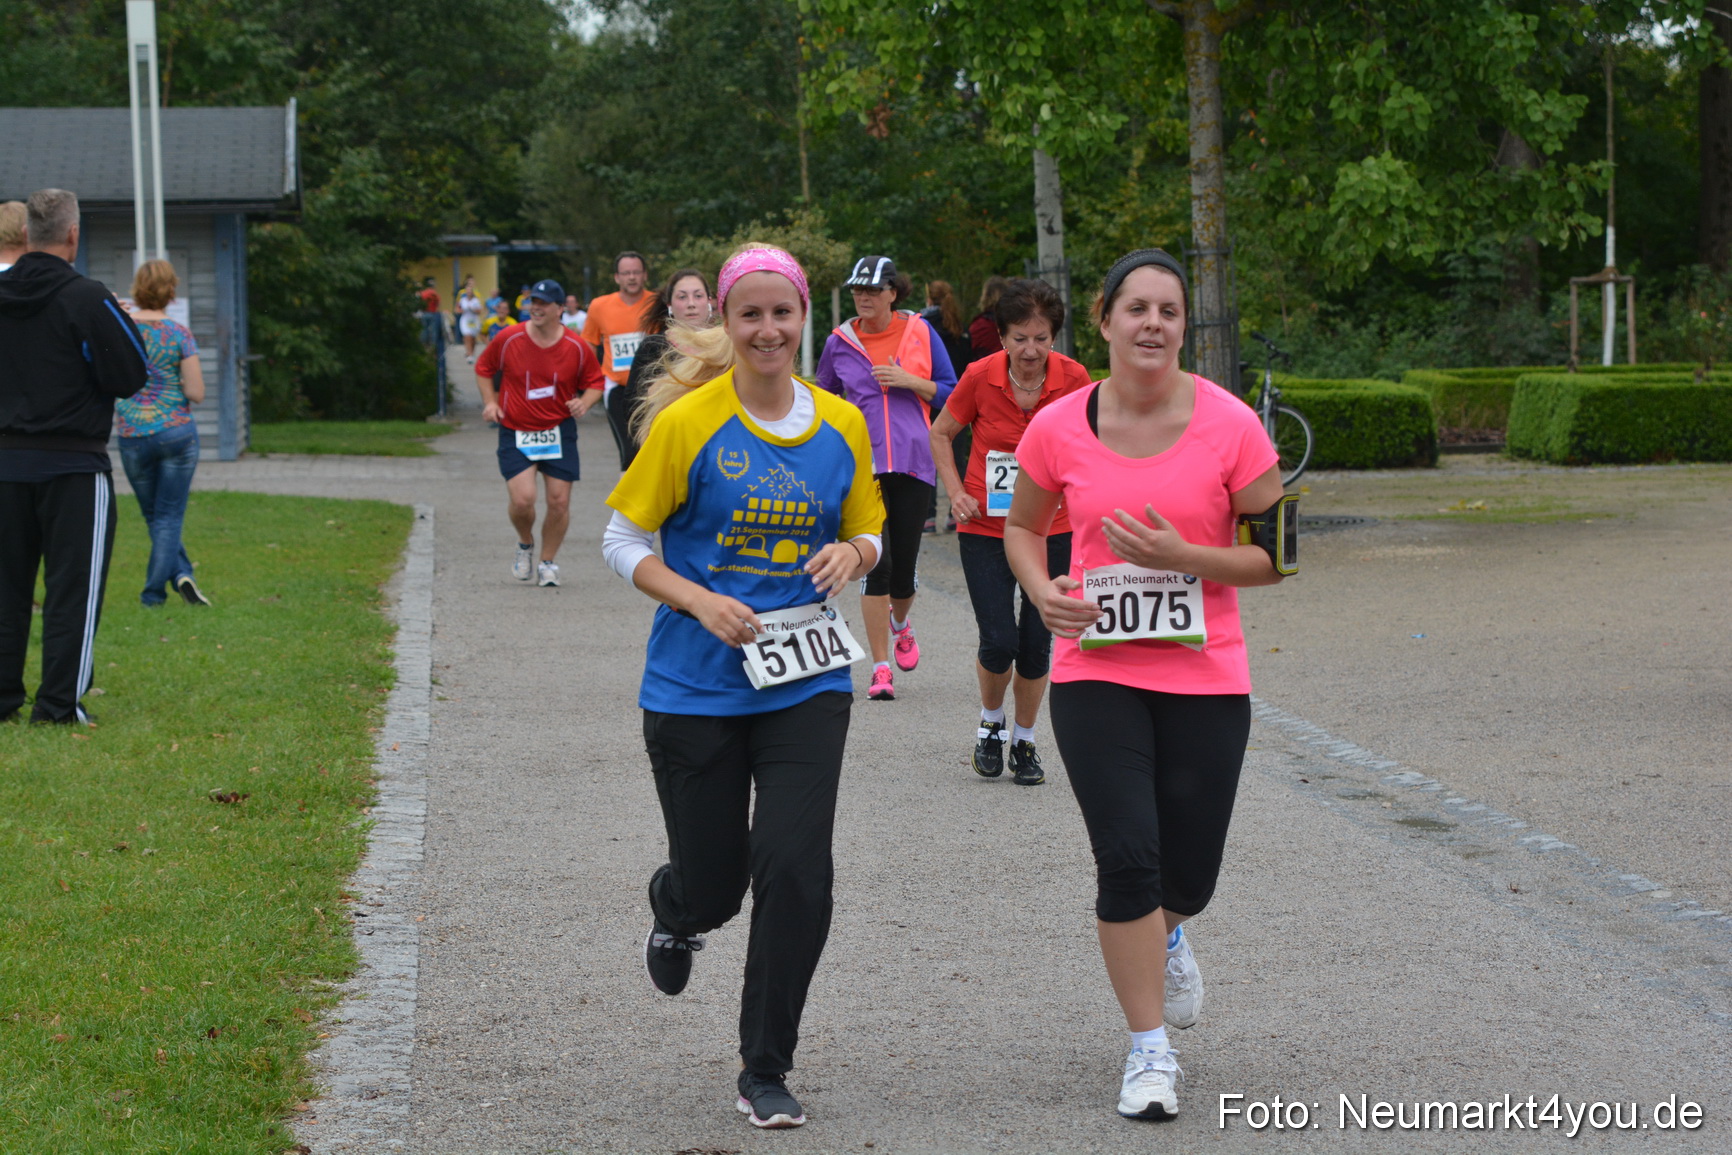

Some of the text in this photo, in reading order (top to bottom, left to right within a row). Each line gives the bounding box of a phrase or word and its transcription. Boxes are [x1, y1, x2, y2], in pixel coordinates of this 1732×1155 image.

[614, 341, 640, 357] 341
[521, 428, 557, 445] 2455
[729, 451, 738, 459] 15
[723, 459, 743, 468] Jahre
[1086, 574, 1178, 589] PARTL Neumarkt
[1095, 590, 1192, 635] 5075
[781, 614, 826, 632] Neumarkt
[756, 626, 853, 678] 5104
